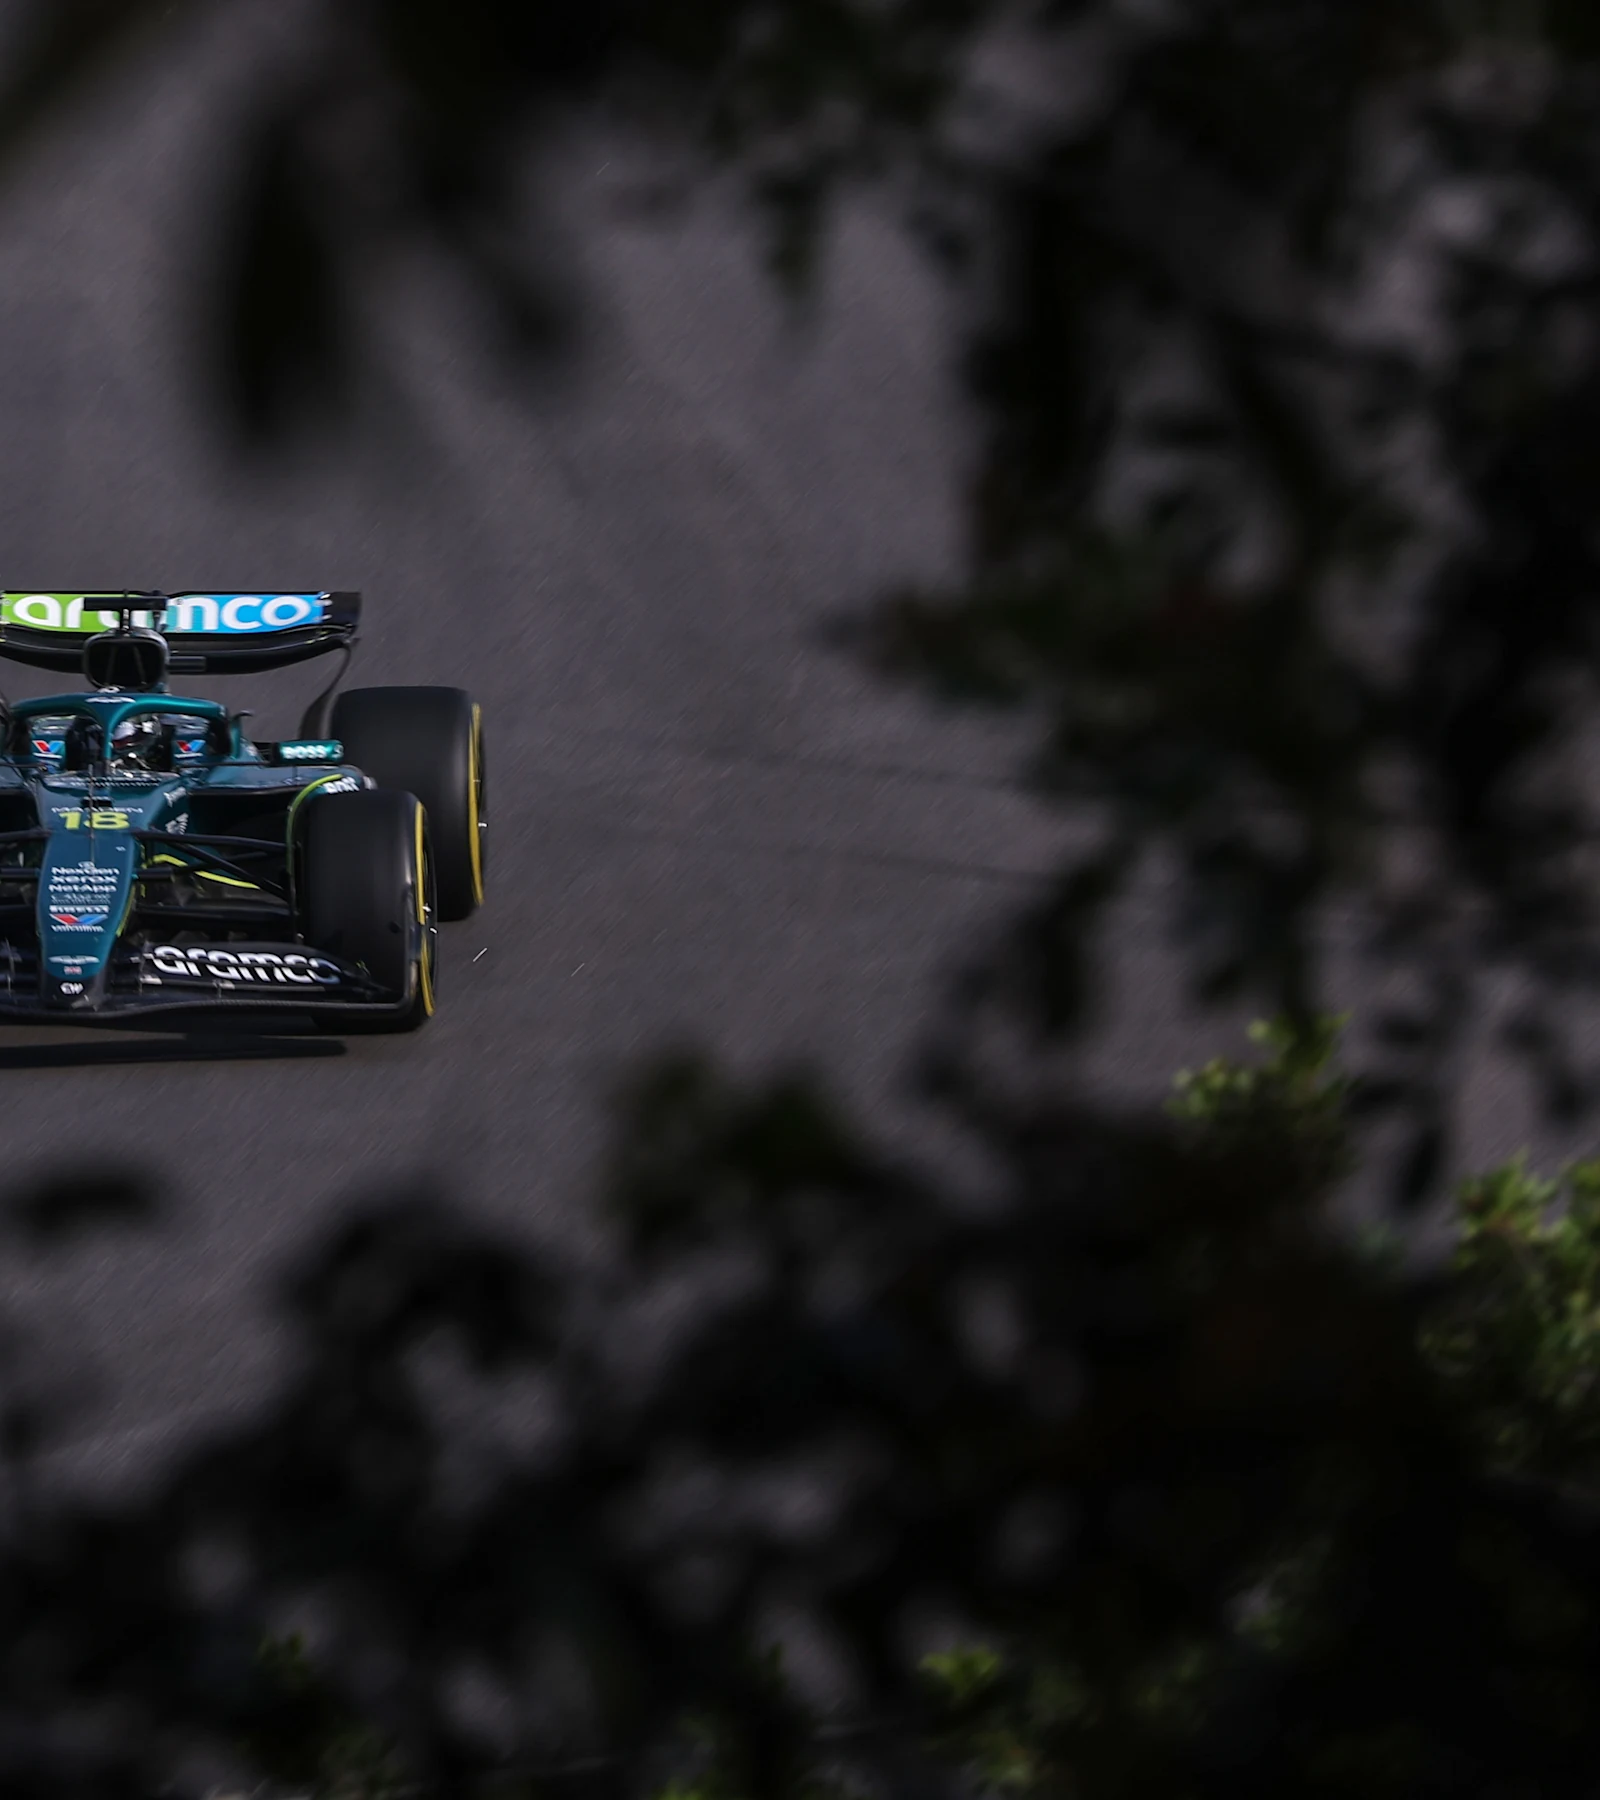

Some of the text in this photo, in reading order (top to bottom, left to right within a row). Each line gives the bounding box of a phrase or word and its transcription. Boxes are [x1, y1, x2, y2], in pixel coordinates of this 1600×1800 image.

[281, 744, 327, 759] BOSS
[58, 811, 130, 830] 18
[51, 866, 120, 875] NexGen
[51, 875, 118, 883] xerox
[48, 884, 117, 893] NetApp
[152, 945, 343, 984] aramco
